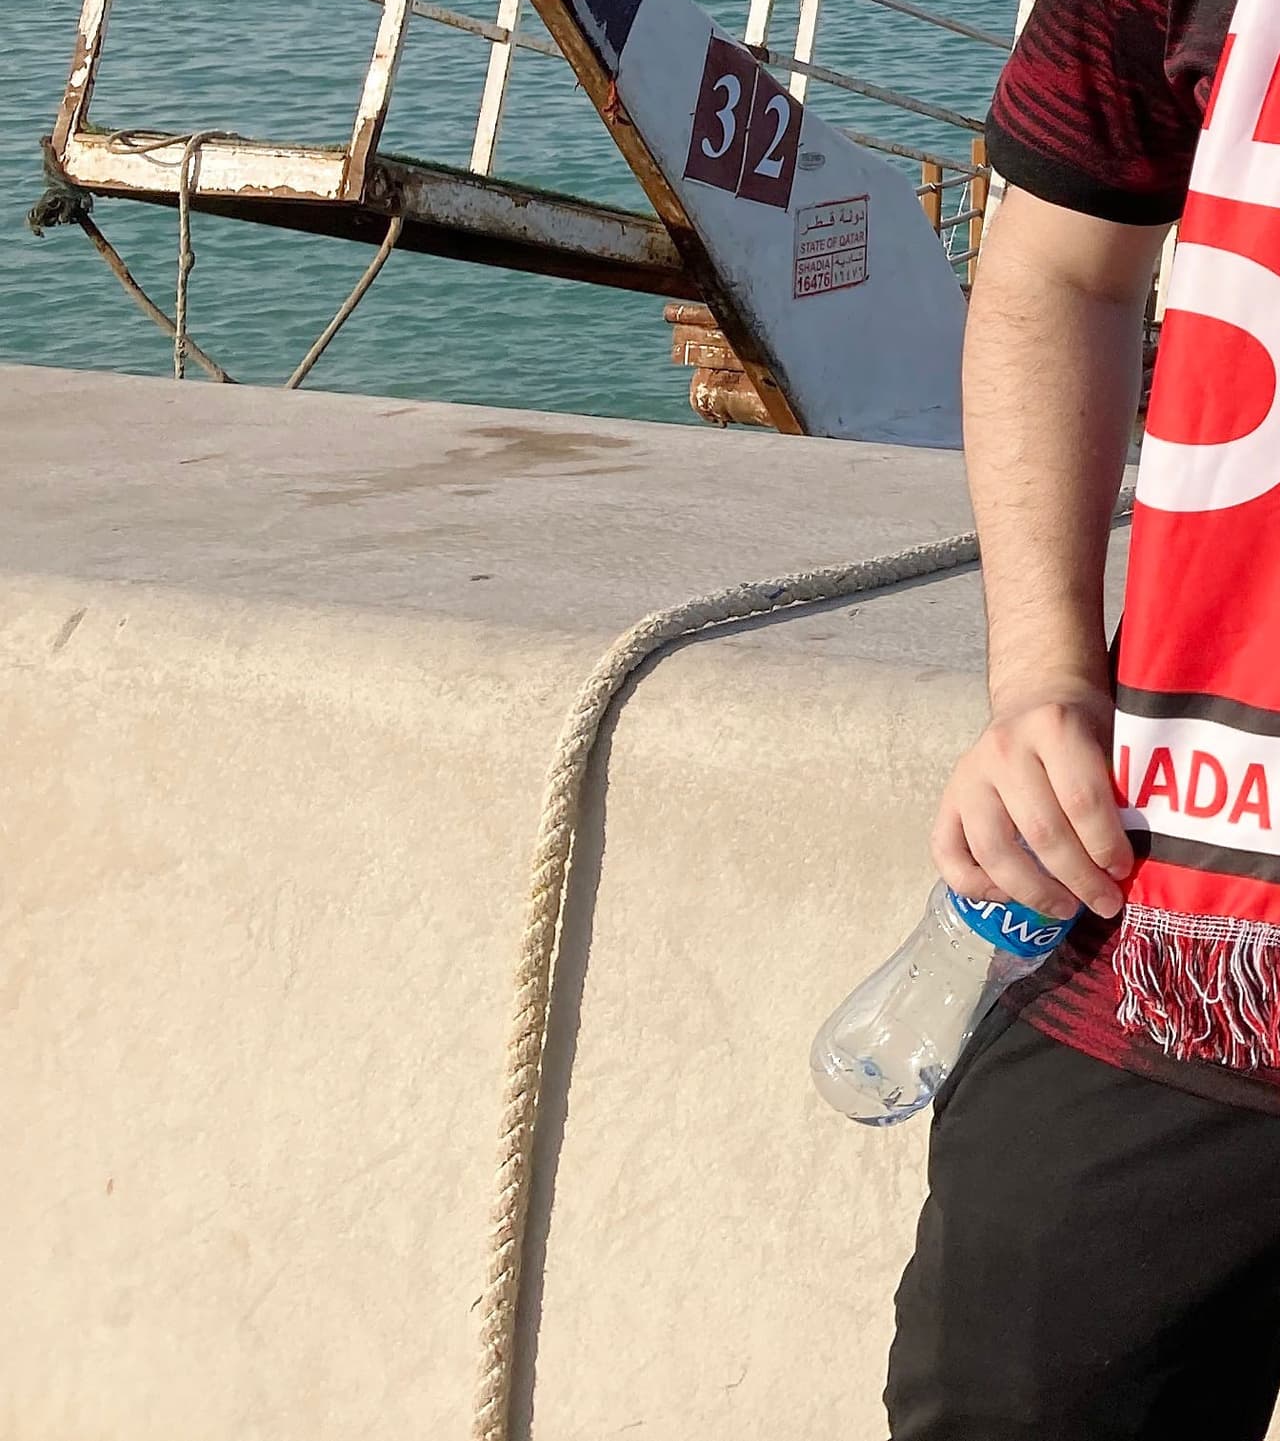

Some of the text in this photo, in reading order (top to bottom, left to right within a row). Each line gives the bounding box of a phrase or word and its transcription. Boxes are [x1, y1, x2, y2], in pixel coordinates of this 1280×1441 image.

[701, 73, 791, 179] 32
[800, 211, 836, 235] قطر
[800, 231, 865, 255] STATE OF QATAR
[798, 258, 831, 274] SHADIA
[797, 271, 831, 293] 16476
